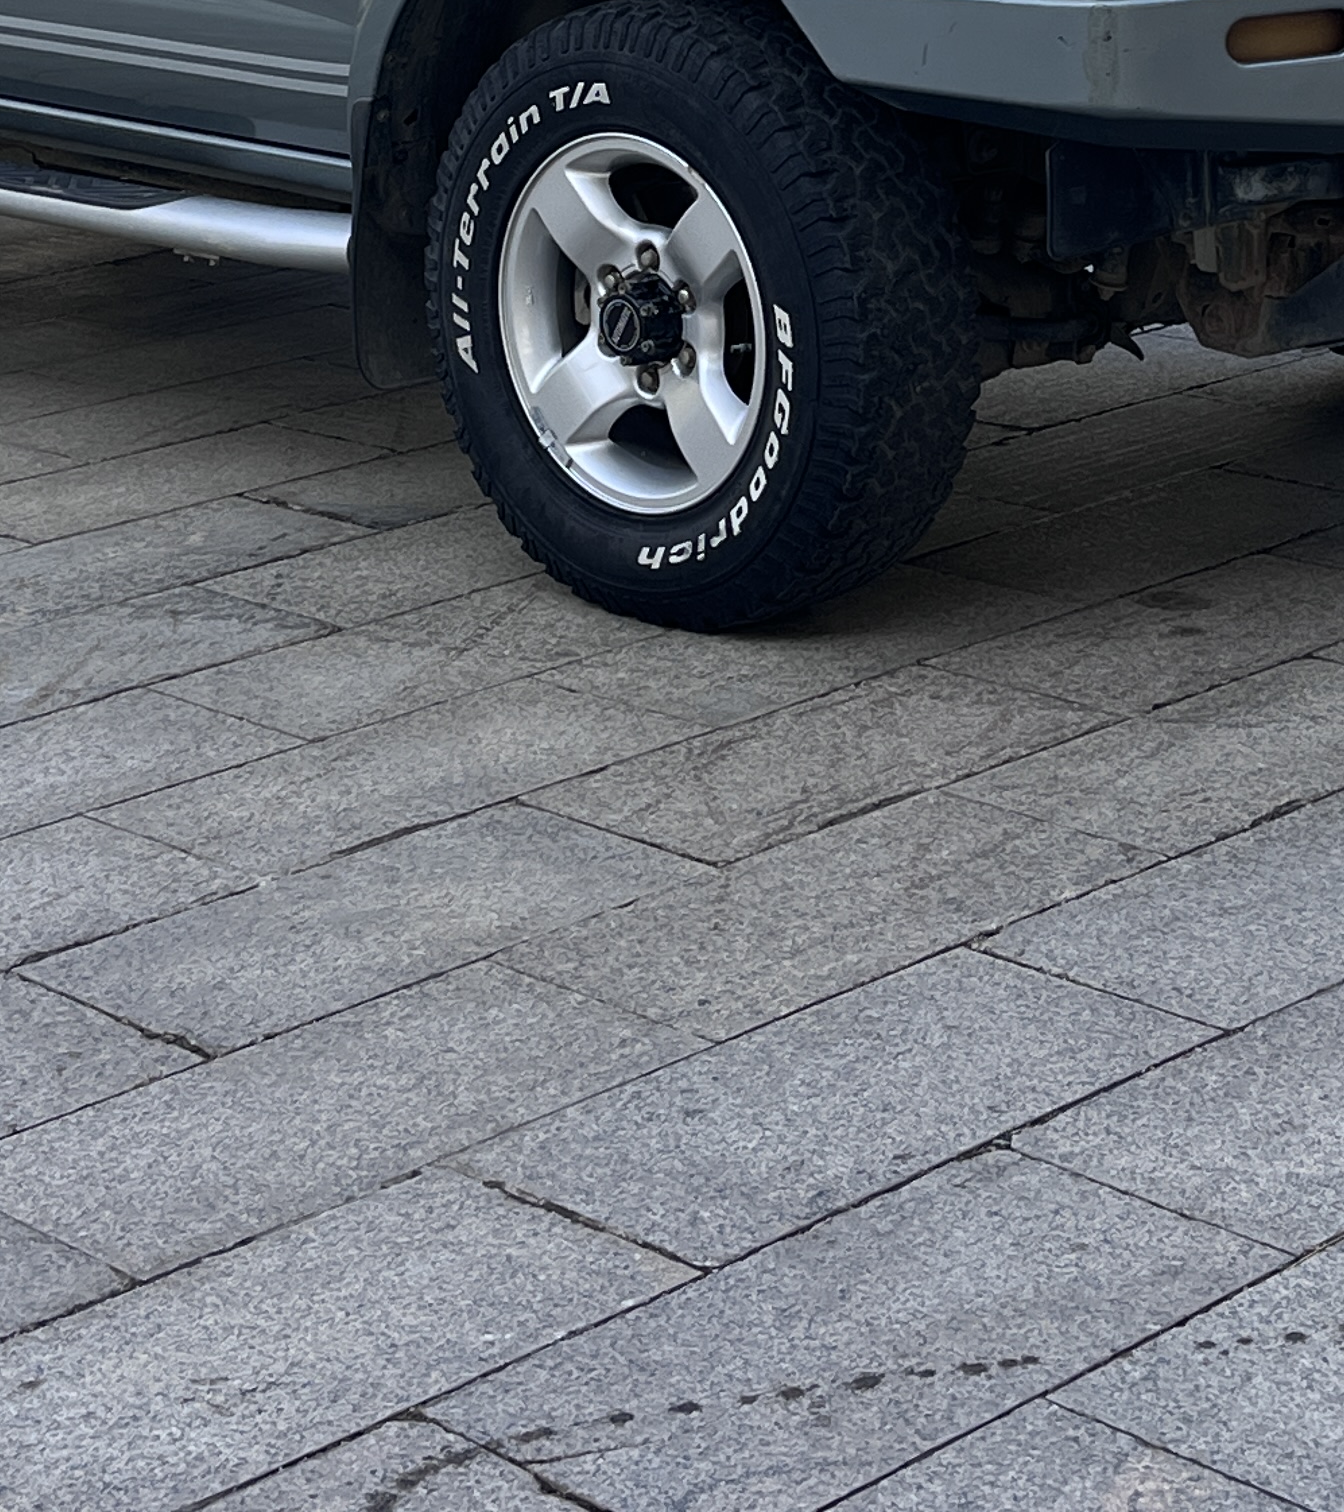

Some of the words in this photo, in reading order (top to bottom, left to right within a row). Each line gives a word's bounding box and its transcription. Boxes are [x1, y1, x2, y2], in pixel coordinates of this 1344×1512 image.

[452, 103, 542, 374] All-Terrain
[549, 82, 611, 113] T/A
[636, 302, 795, 571] BFGoodrich
